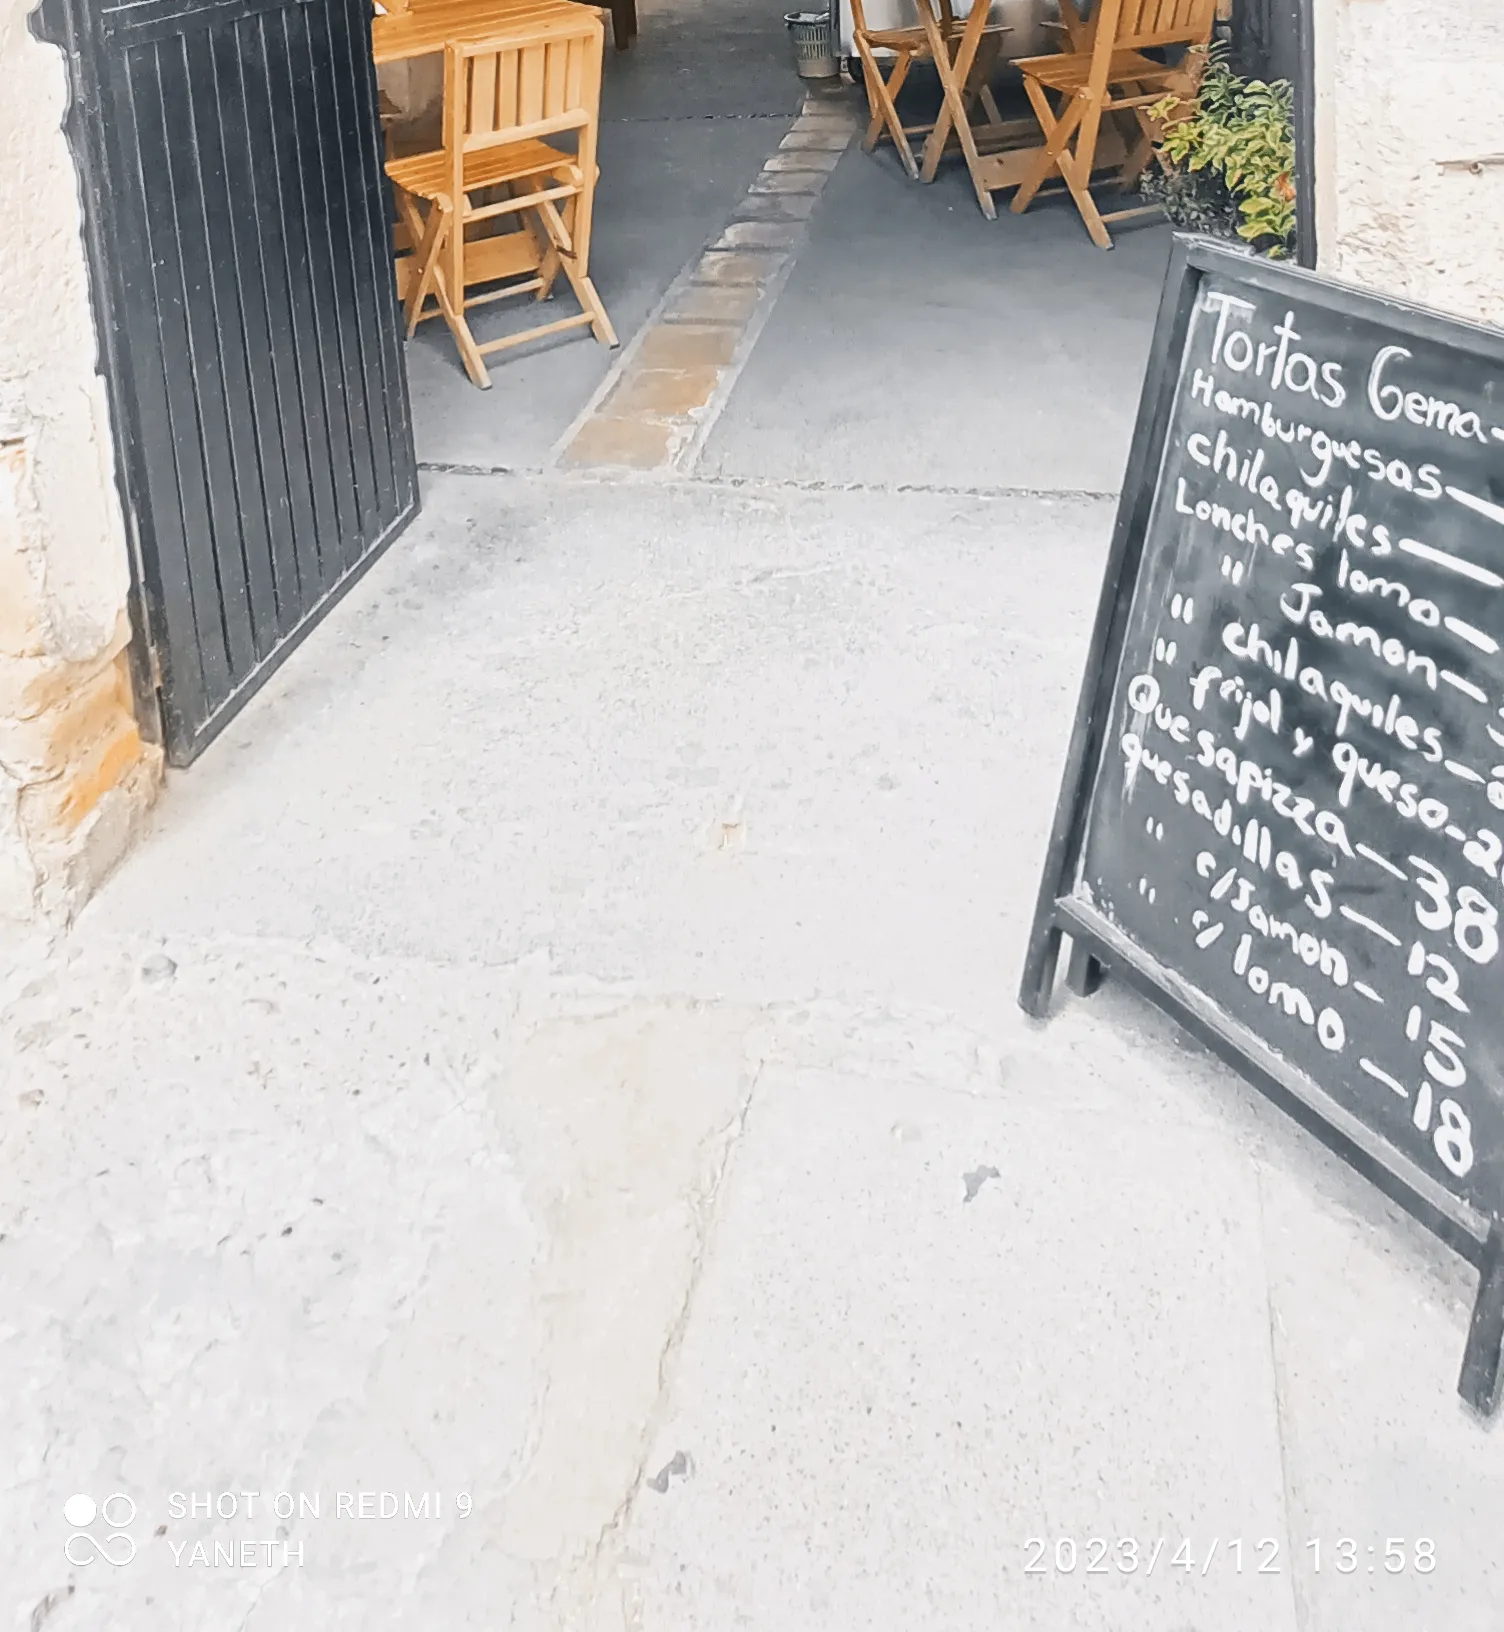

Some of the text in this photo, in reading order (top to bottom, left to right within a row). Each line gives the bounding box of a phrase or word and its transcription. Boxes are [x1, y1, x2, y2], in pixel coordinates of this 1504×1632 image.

[1207, 290, 1348, 408] Tortas
[1190, 367, 1443, 499] Hamburguesas
[1186, 431, 1393, 556] chilaquiles
[1175, 476, 1440, 627] Lonches lomo
[1222, 621, 1443, 763] chilaquiles
[1279, 582, 1438, 691] Jamon
[1408, 855, 1499, 965] 38
[1407, 940, 1471, 1014] 12
[1405, 1005, 1468, 1088] 15
[1413, 1081, 1474, 1178] 18
